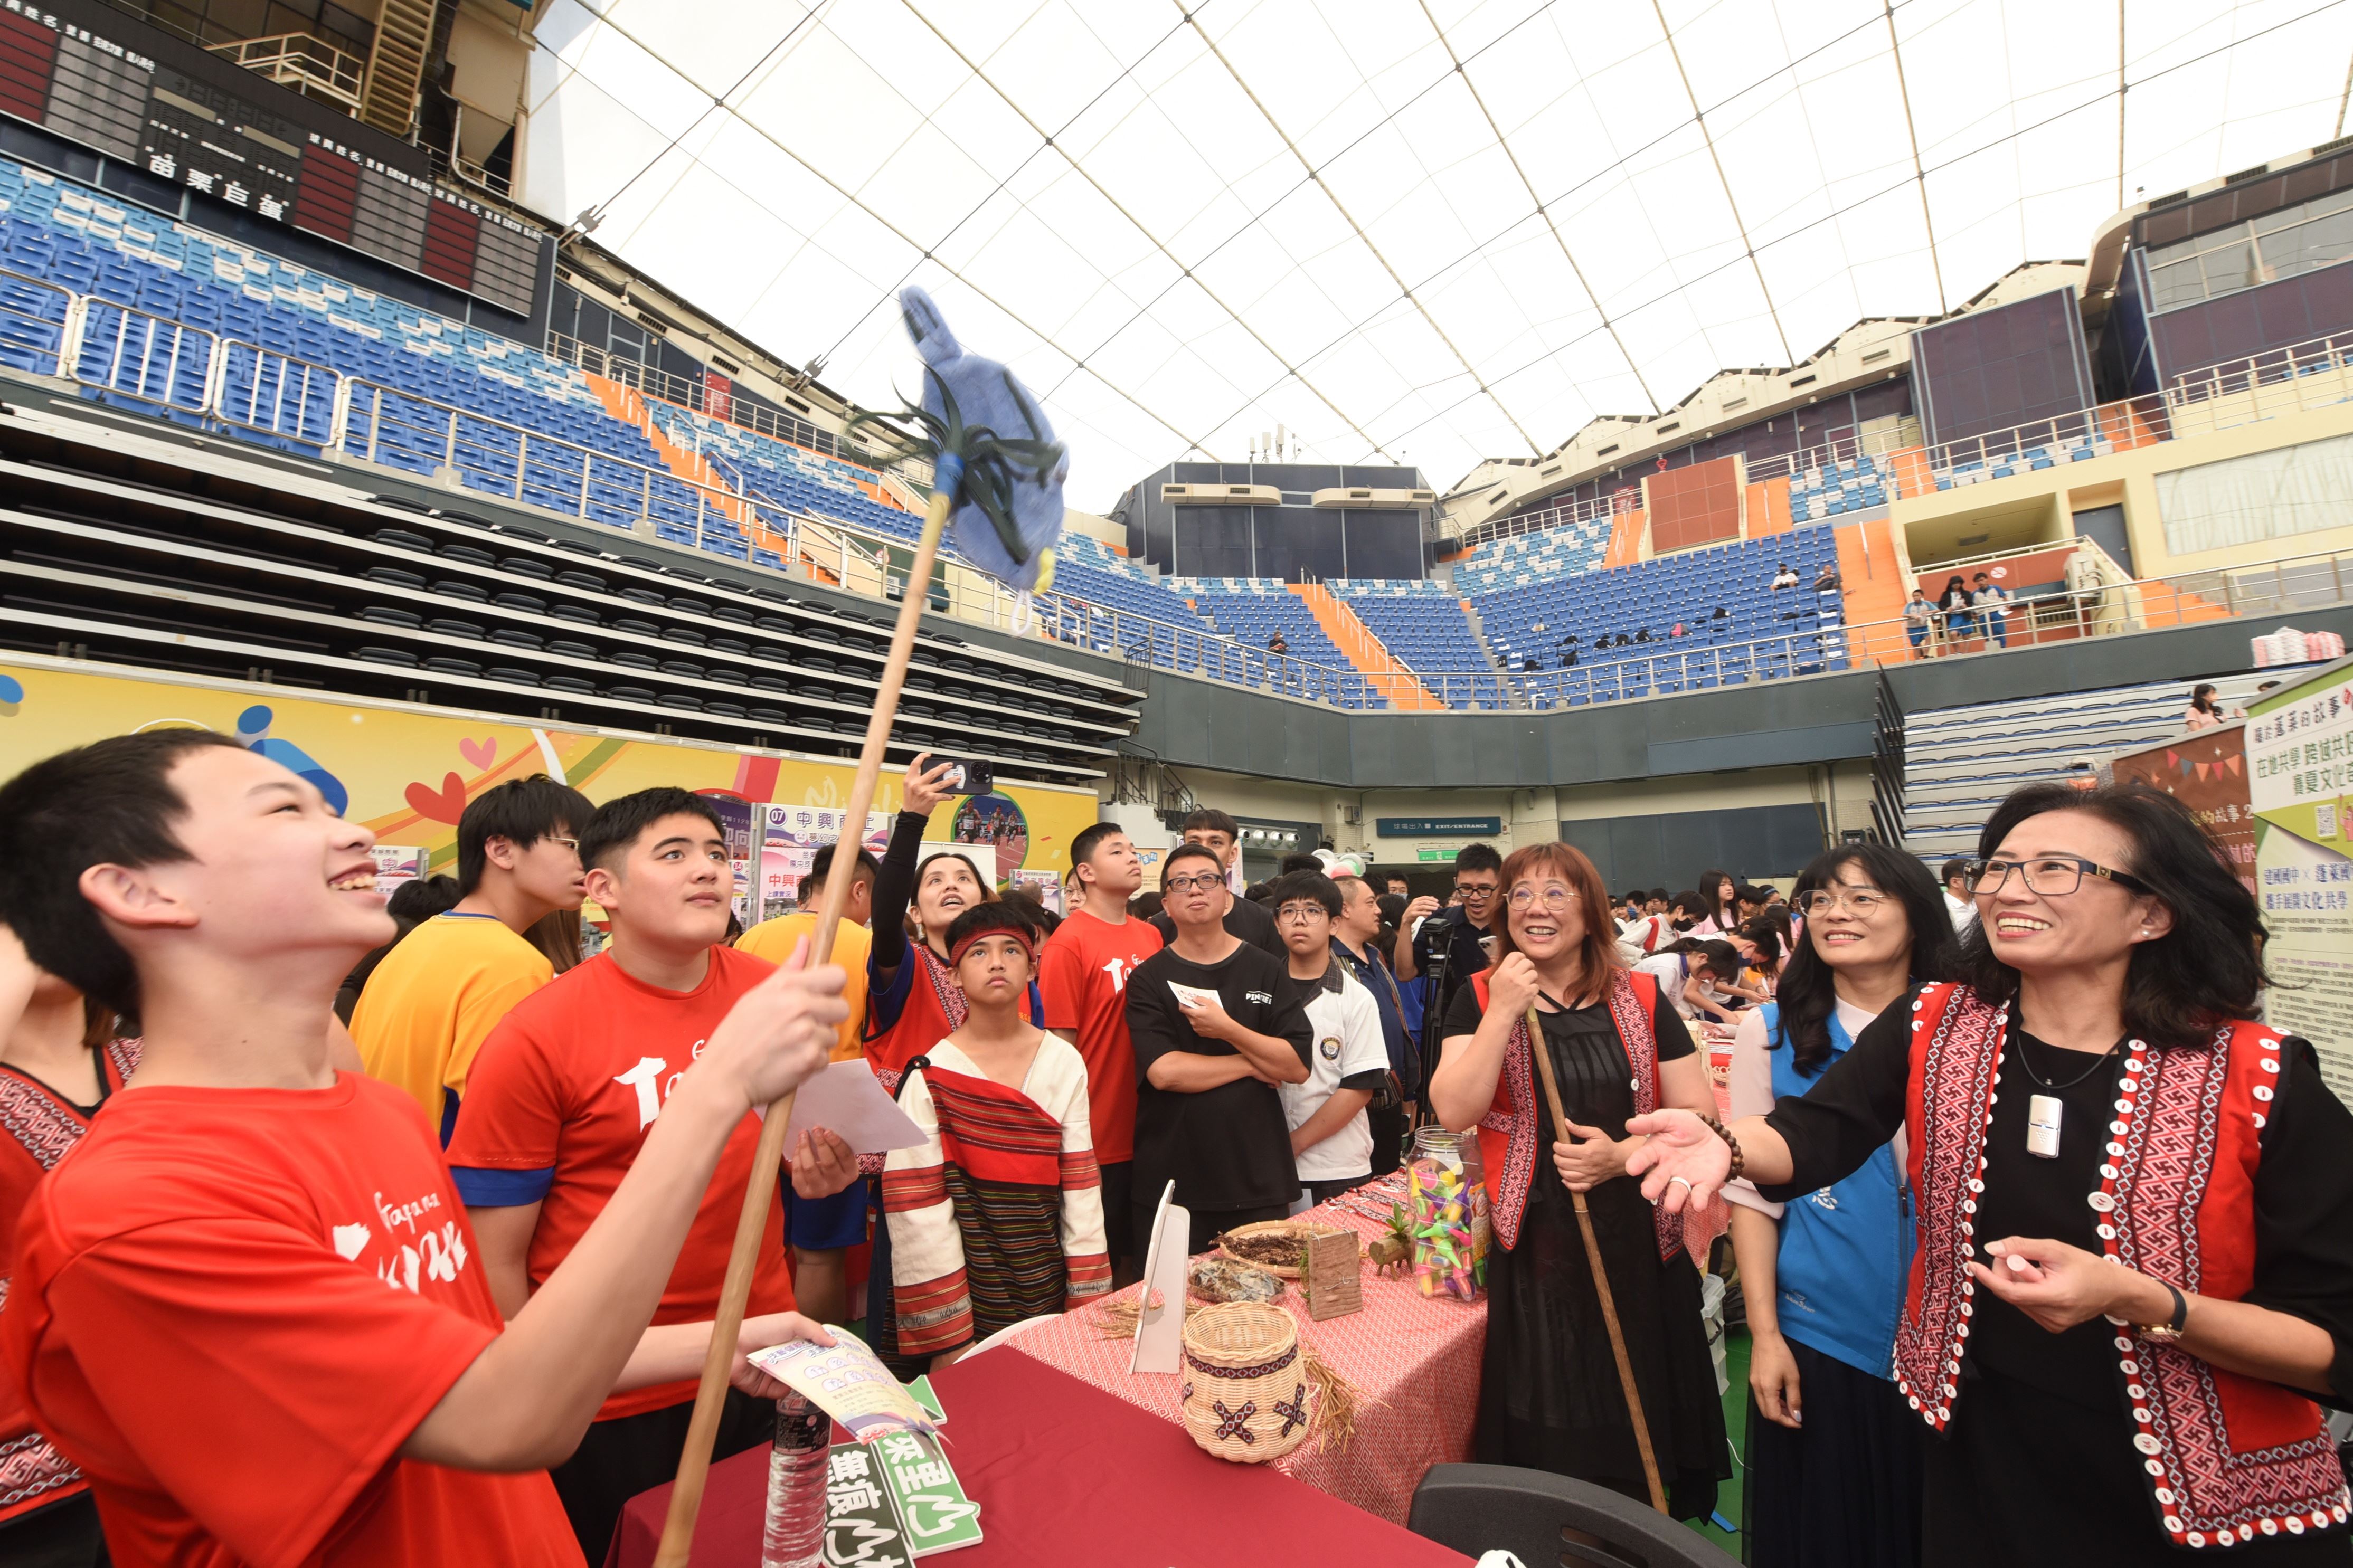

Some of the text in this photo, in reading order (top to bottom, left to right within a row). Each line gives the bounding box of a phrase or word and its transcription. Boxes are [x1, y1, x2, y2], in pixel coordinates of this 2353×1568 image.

[149, 155, 284, 221] 苗栗巨蛋
[772, 812, 783, 822] 07
[808, 832, 839, 844] 夢幻之
[2314, 861, 2353, 883] 蓬萊國
[882, 1433, 977, 1538] 來里山
